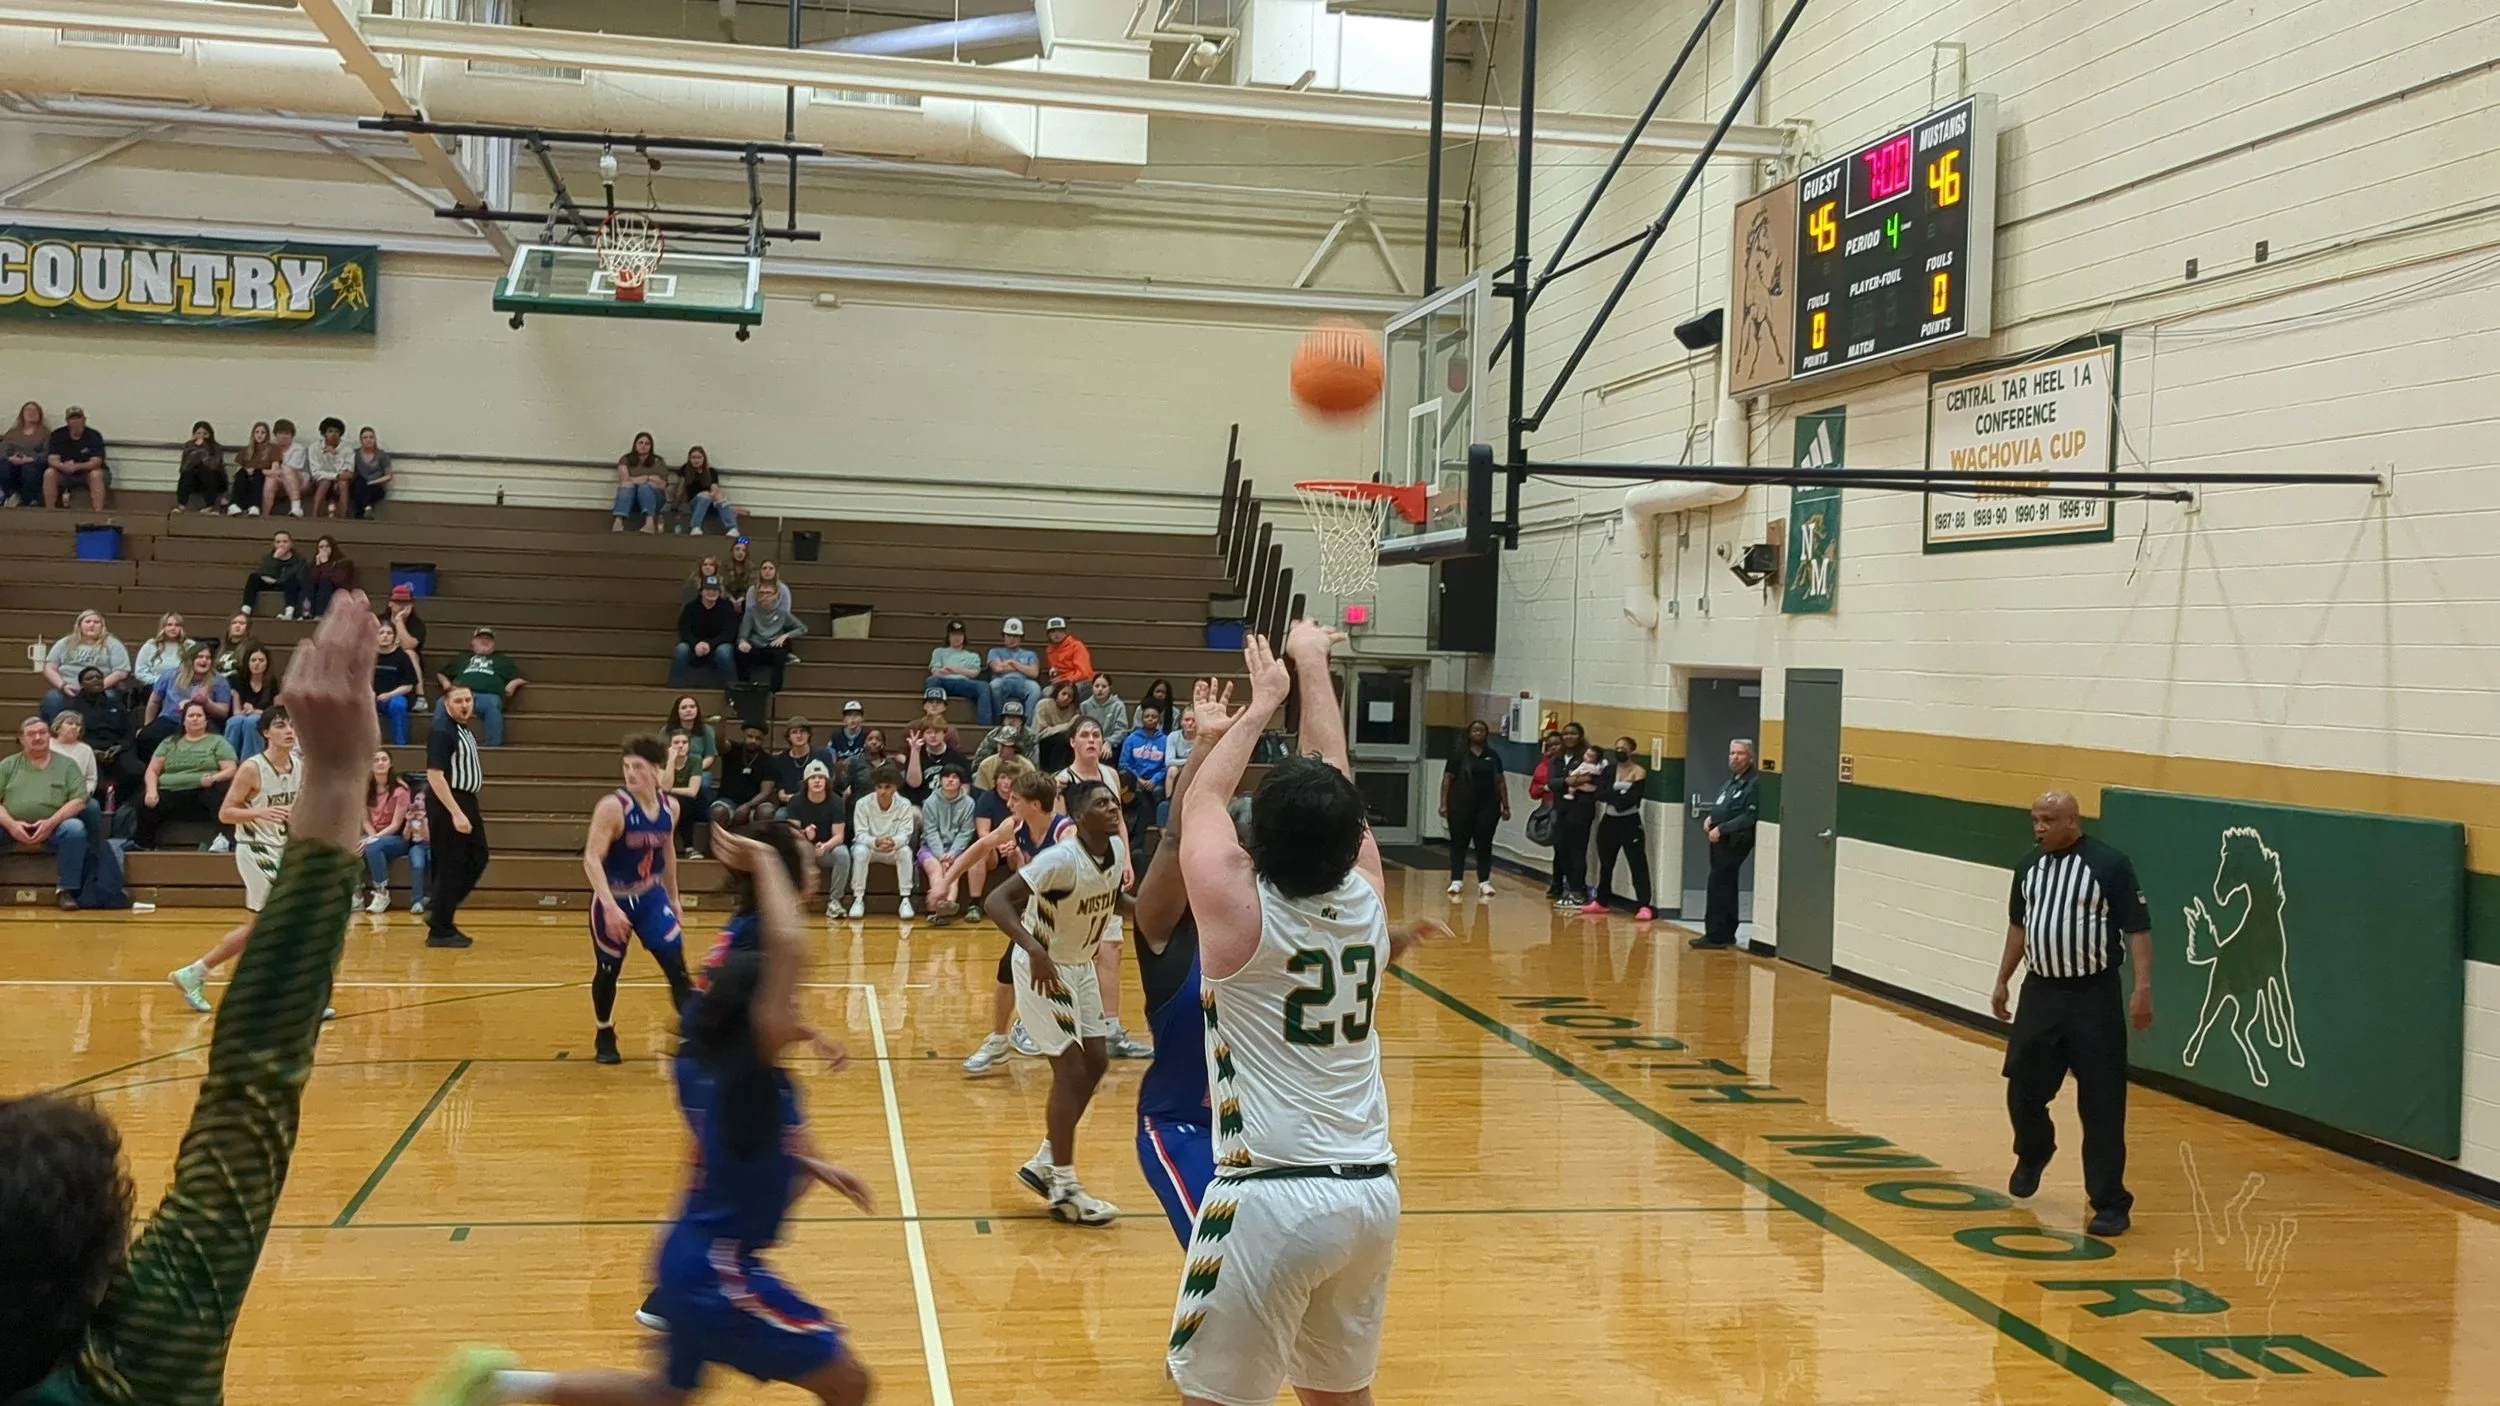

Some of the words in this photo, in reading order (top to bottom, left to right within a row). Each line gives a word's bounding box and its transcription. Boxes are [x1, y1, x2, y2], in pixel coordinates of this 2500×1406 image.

[1919, 111, 1967, 152] MUSTANGS
[1803, 168, 1841, 202] GUEST
[1928, 149, 1961, 207] 46
[1809, 202, 1837, 253] 45
[1845, 229, 1881, 258] PERIOD
[1886, 212, 1898, 249] 4
[0, 237, 328, 320] COUNTRY
[1925, 251, 1954, 273] FOULS
[1807, 292, 1831, 312] FOULS
[1849, 268, 1903, 298] PLAYER-FOUL
[1931, 272, 1948, 316] 0
[1811, 312, 1826, 350] 0
[1920, 317, 1952, 338] POINTS
[1803, 351, 1829, 370] POINTS
[1847, 339, 1876, 358] MATCH
[1946, 382, 1996, 412] CENTRAL
[2001, 376, 2027, 402] TAR
[2033, 369, 2065, 396] HEEL
[1975, 401, 2057, 436] CONFERENCE
[1950, 437, 2043, 471] WACHOVIA
[2049, 430, 2087, 460] CUP
[1800, 522, 1816, 561] N
[1810, 558, 1830, 596] M
[1283, 943, 1377, 1048] 23
[1495, 995, 1809, 1105] NORTH
[1764, 1134, 2389, 1381] MOORE
